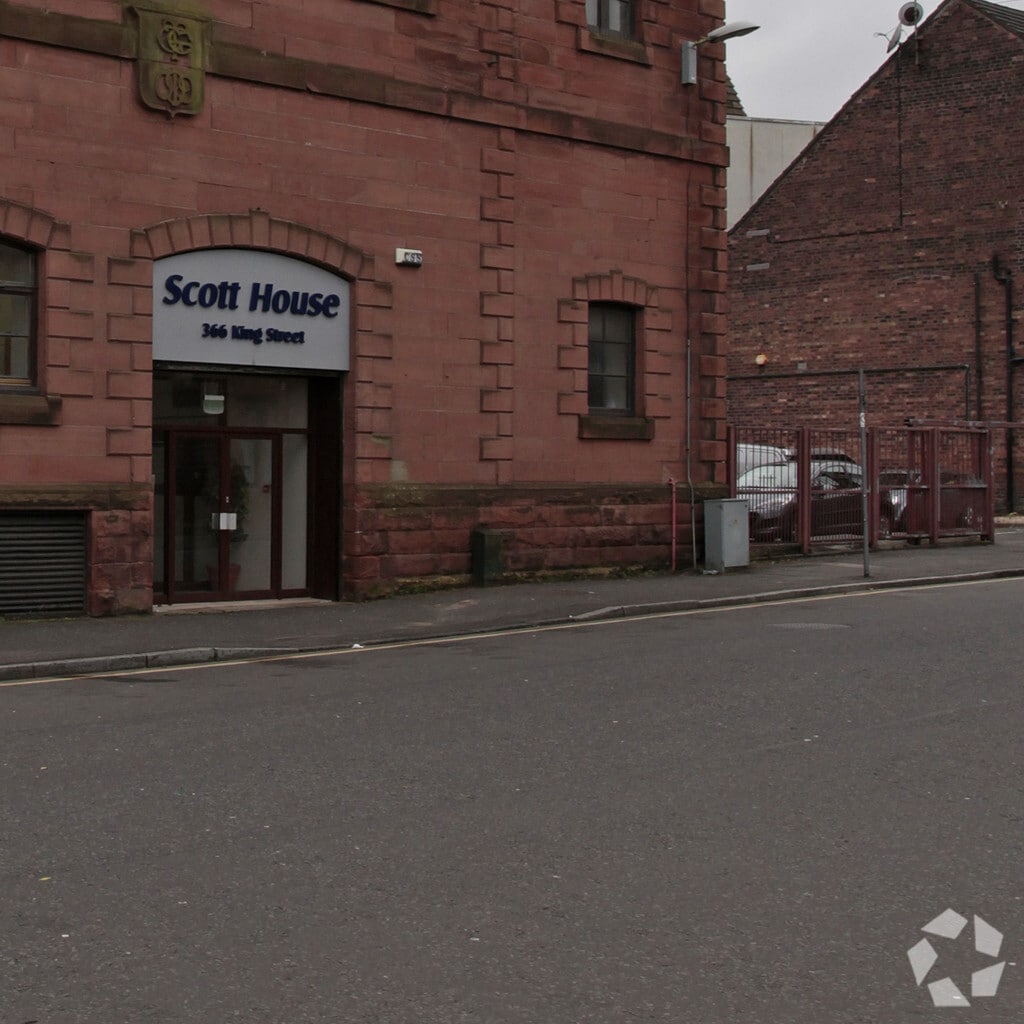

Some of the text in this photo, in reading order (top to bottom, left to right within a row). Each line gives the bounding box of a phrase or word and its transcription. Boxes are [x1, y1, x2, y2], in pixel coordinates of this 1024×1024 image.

[162, 274, 340, 318] Scott House
[201, 323, 305, 345] 366 King Street
